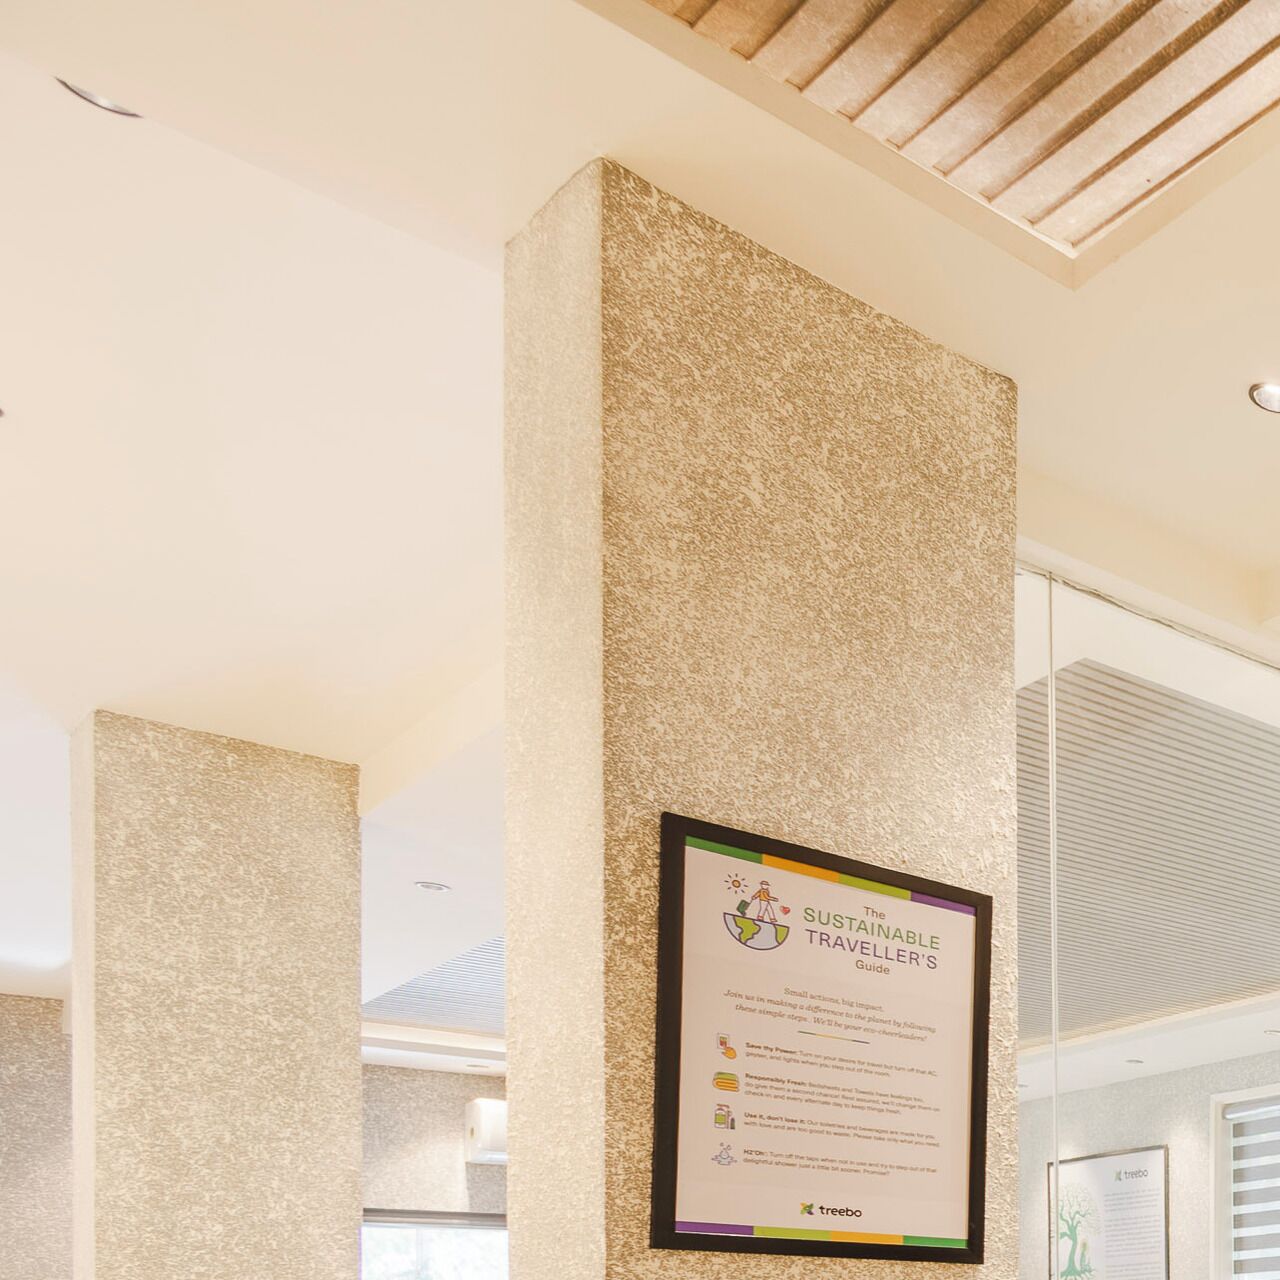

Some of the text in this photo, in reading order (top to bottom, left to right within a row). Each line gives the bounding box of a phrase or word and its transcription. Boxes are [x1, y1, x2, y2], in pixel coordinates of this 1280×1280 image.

[863, 905, 885, 920] The
[803, 906, 940, 950] SUSTAINABLE
[804, 927, 937, 970] TRAVELLER'S
[855, 958, 890, 975] Guide
[784, 987, 808, 998] Small
[841, 997, 854, 1008] big
[723, 988, 742, 999] Join
[744, 993, 754, 1001] us
[756, 994, 764, 1003] in
[766, 995, 797, 1010] making
[805, 1002, 843, 1017] difference
[845, 1009, 853, 1018] to
[854, 1011, 866, 1020] the
[867, 1013, 891, 1027] planet
[893, 1018, 901, 1028] by
[759, 1007, 785, 1020] simple
[834, 1020, 842, 1028] be
[744, 1072, 785, 1084] Responsibly
[1124, 1169, 1149, 1180] treebo
[818, 1204, 862, 1217] treebo
